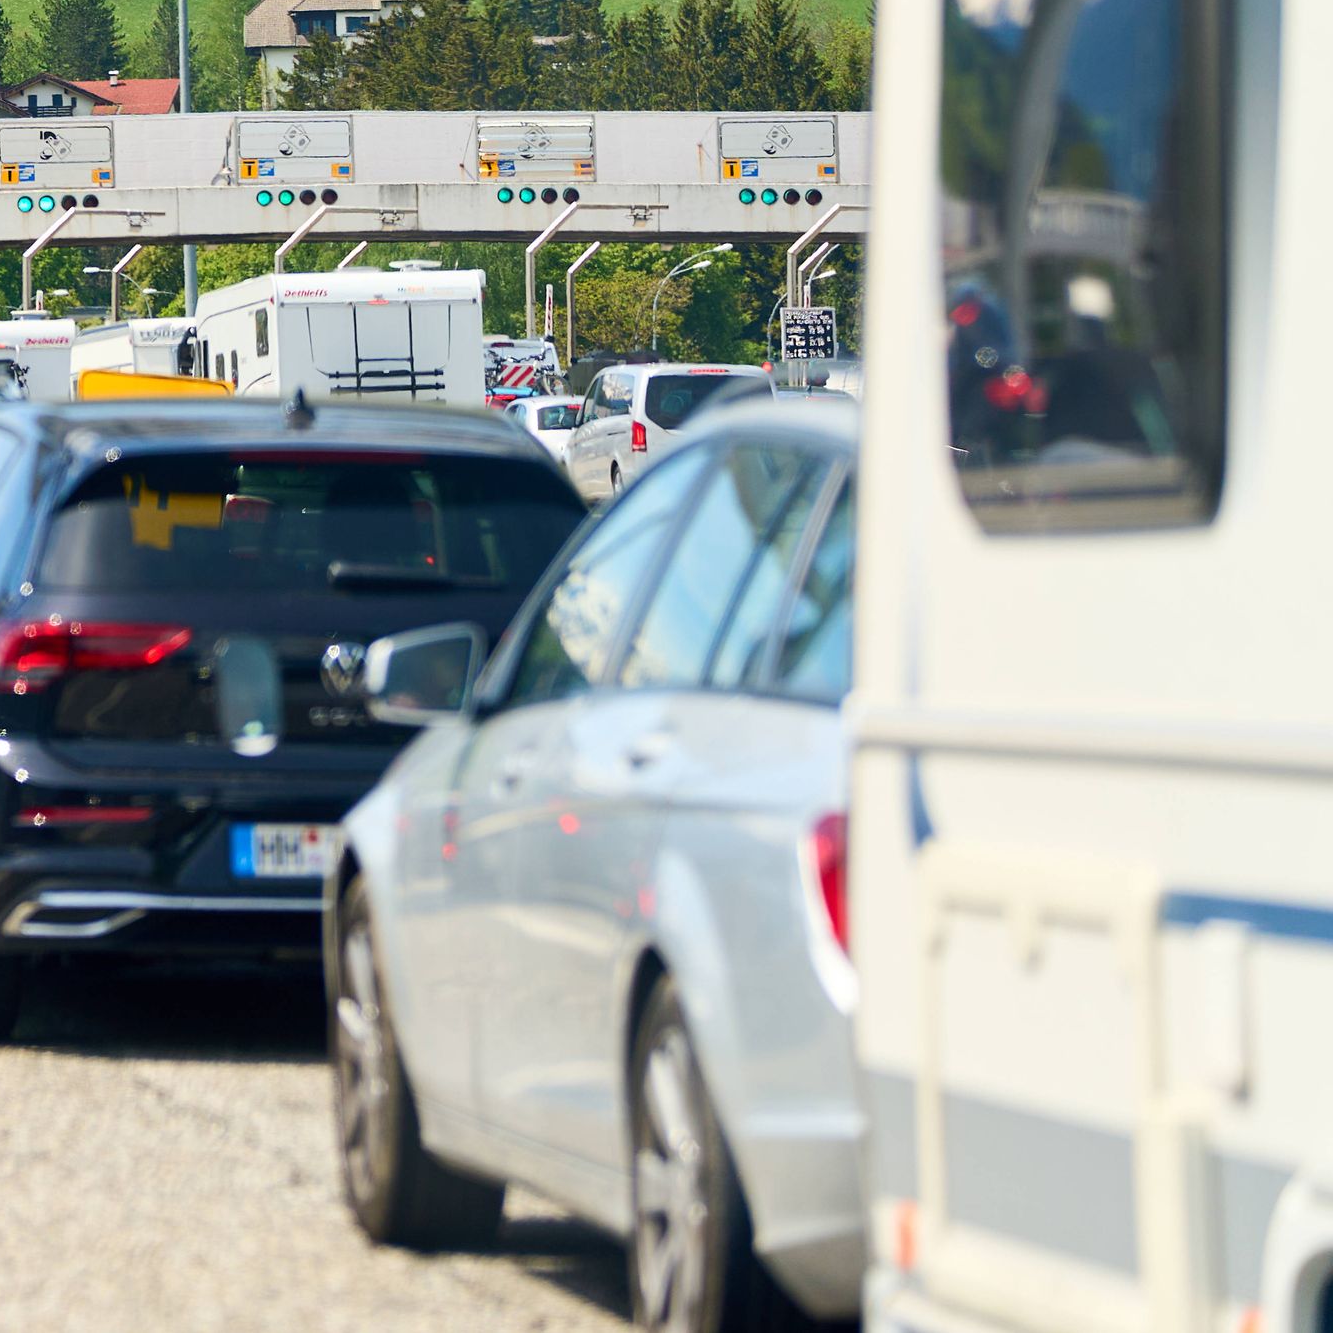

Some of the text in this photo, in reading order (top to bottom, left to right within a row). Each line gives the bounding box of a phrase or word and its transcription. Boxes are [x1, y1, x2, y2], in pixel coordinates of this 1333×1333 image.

[3, 165, 16, 182] T
[242, 161, 256, 177] T
[725, 160, 738, 177] T
